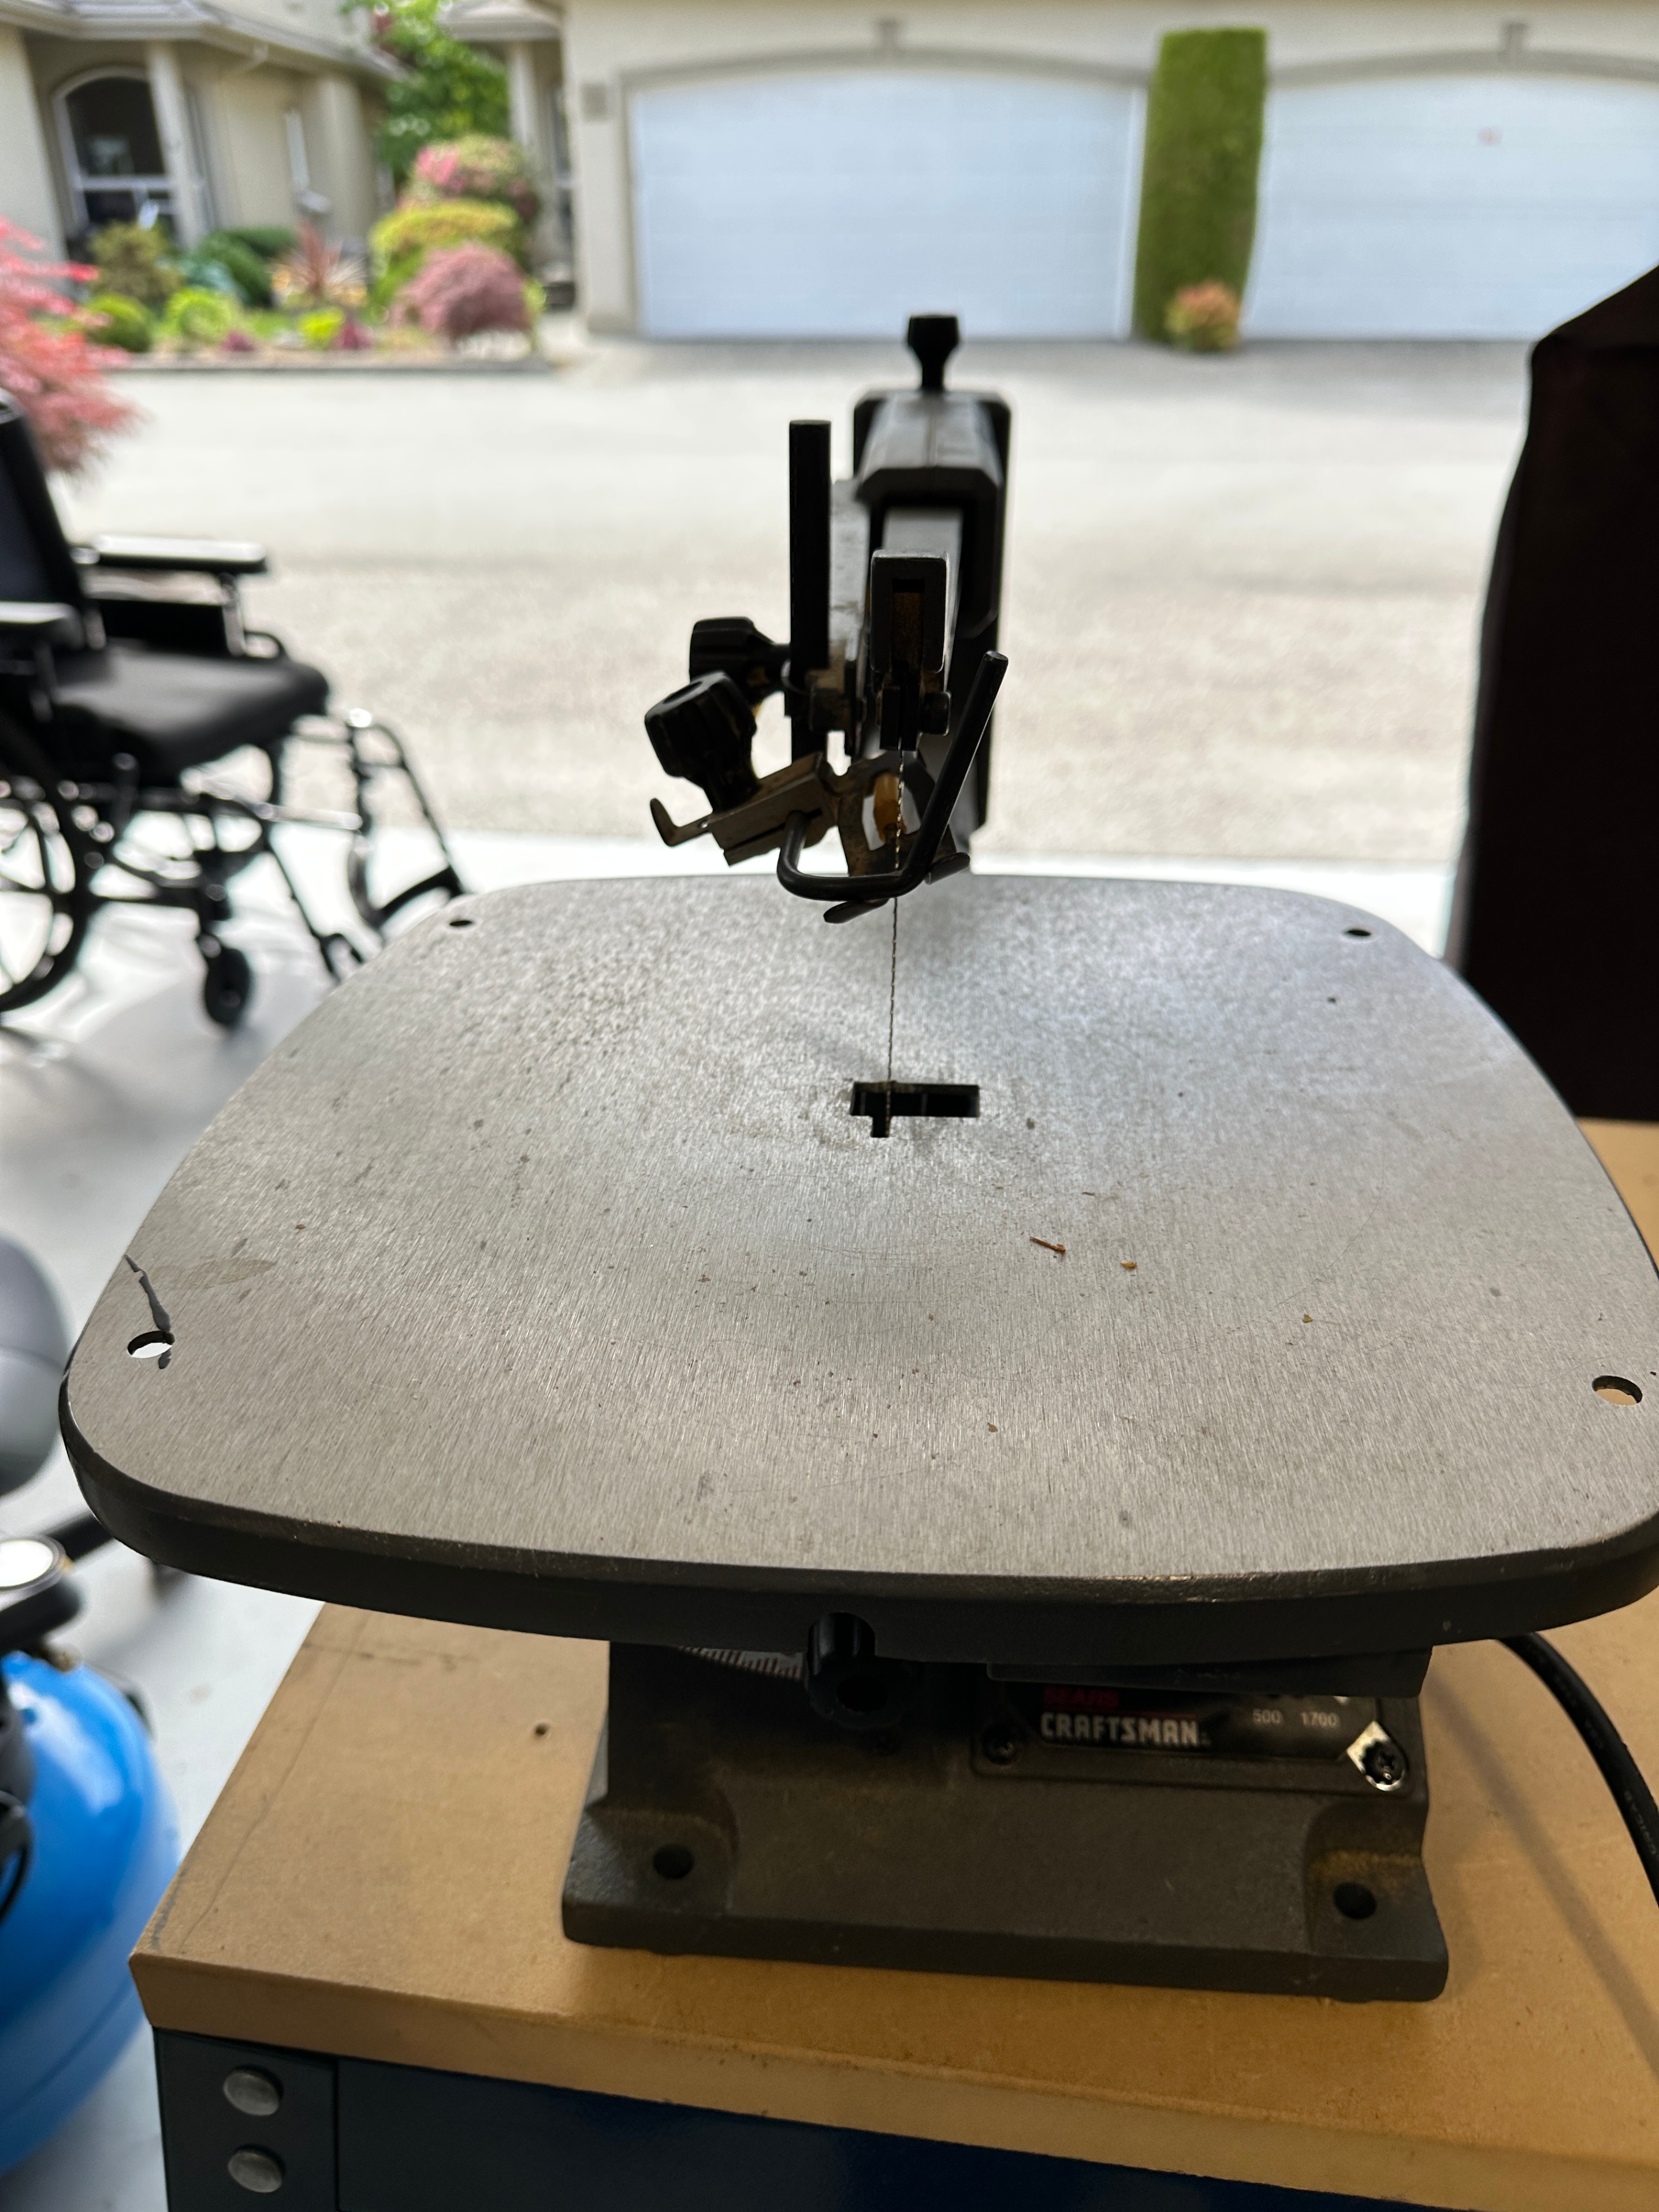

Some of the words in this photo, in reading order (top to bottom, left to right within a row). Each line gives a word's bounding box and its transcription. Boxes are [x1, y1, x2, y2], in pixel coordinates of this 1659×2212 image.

[1040, 1711, 1199, 1747] CRAFTSMAN
[1252, 1708, 1281, 1725] 500
[1301, 1711, 1340, 1728] 1700
